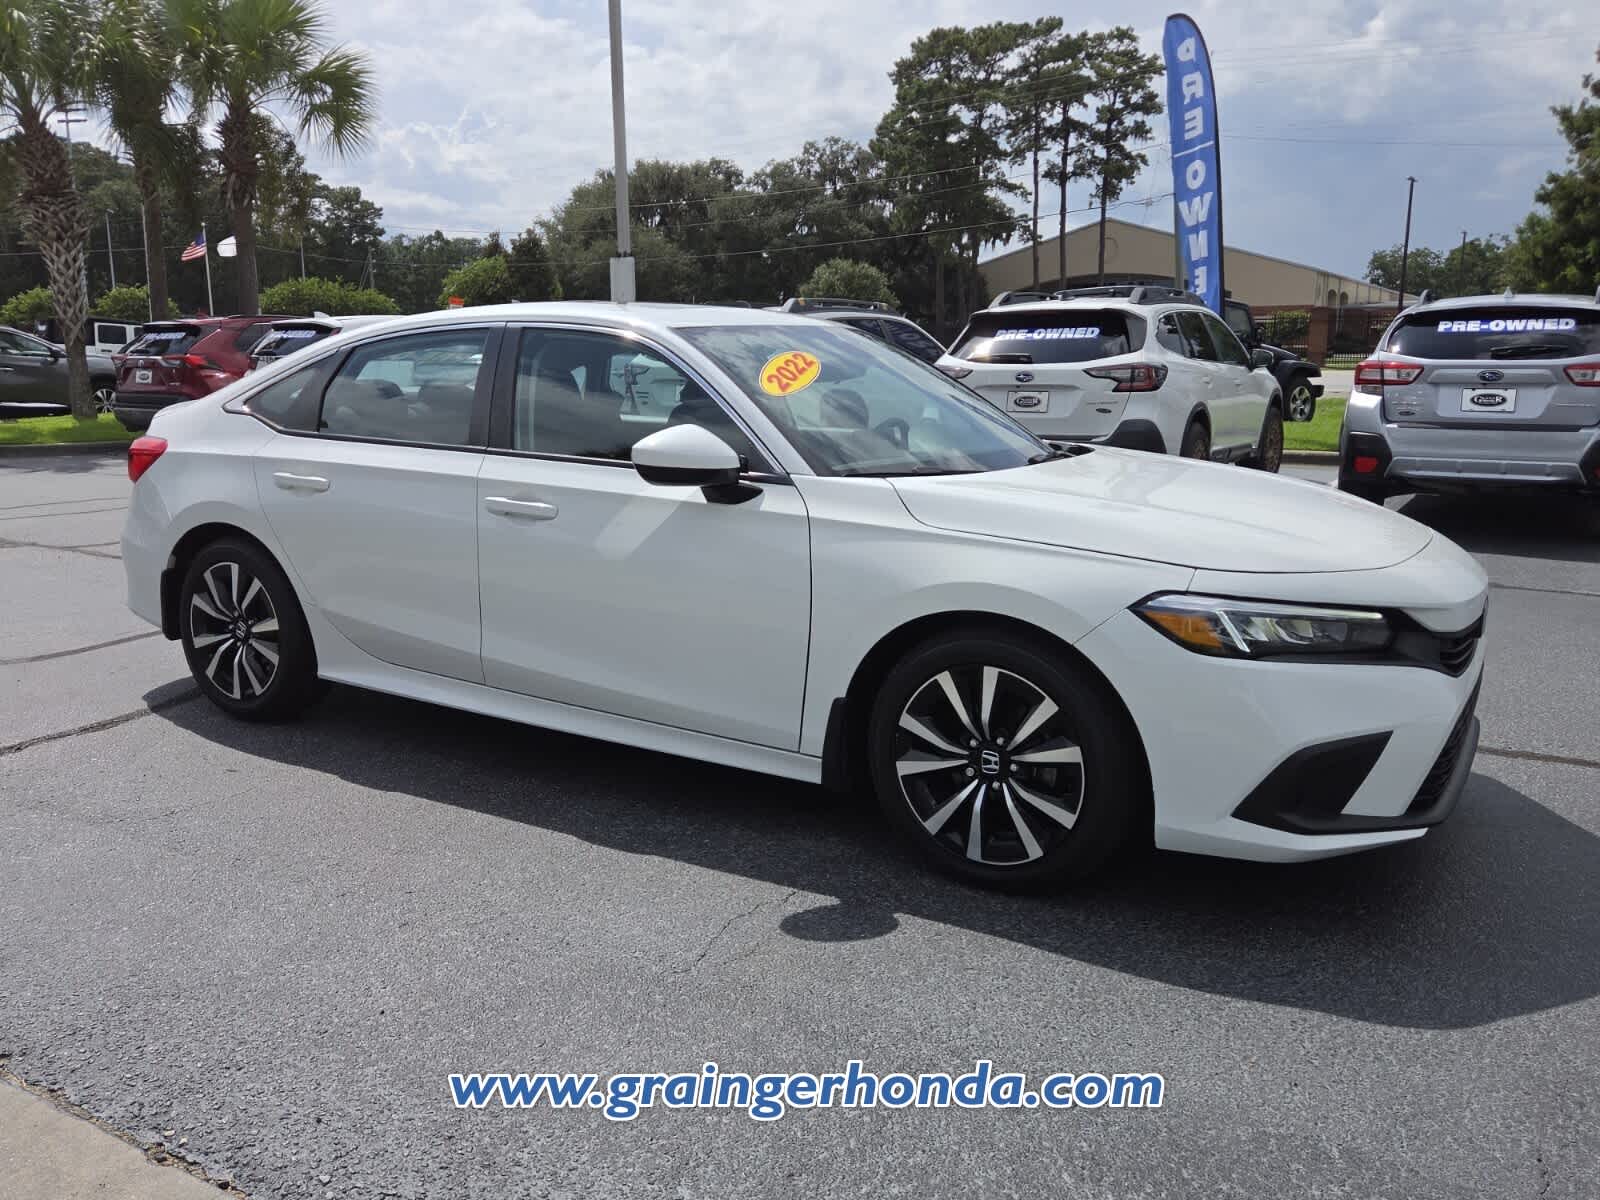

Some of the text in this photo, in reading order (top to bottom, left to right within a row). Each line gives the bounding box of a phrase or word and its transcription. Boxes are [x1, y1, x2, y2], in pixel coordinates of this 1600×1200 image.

[1437, 318, 1576, 333] PRE-OWNED
[992, 327, 1100, 341] PRE-OWNED
[767, 353, 816, 392] 2022
